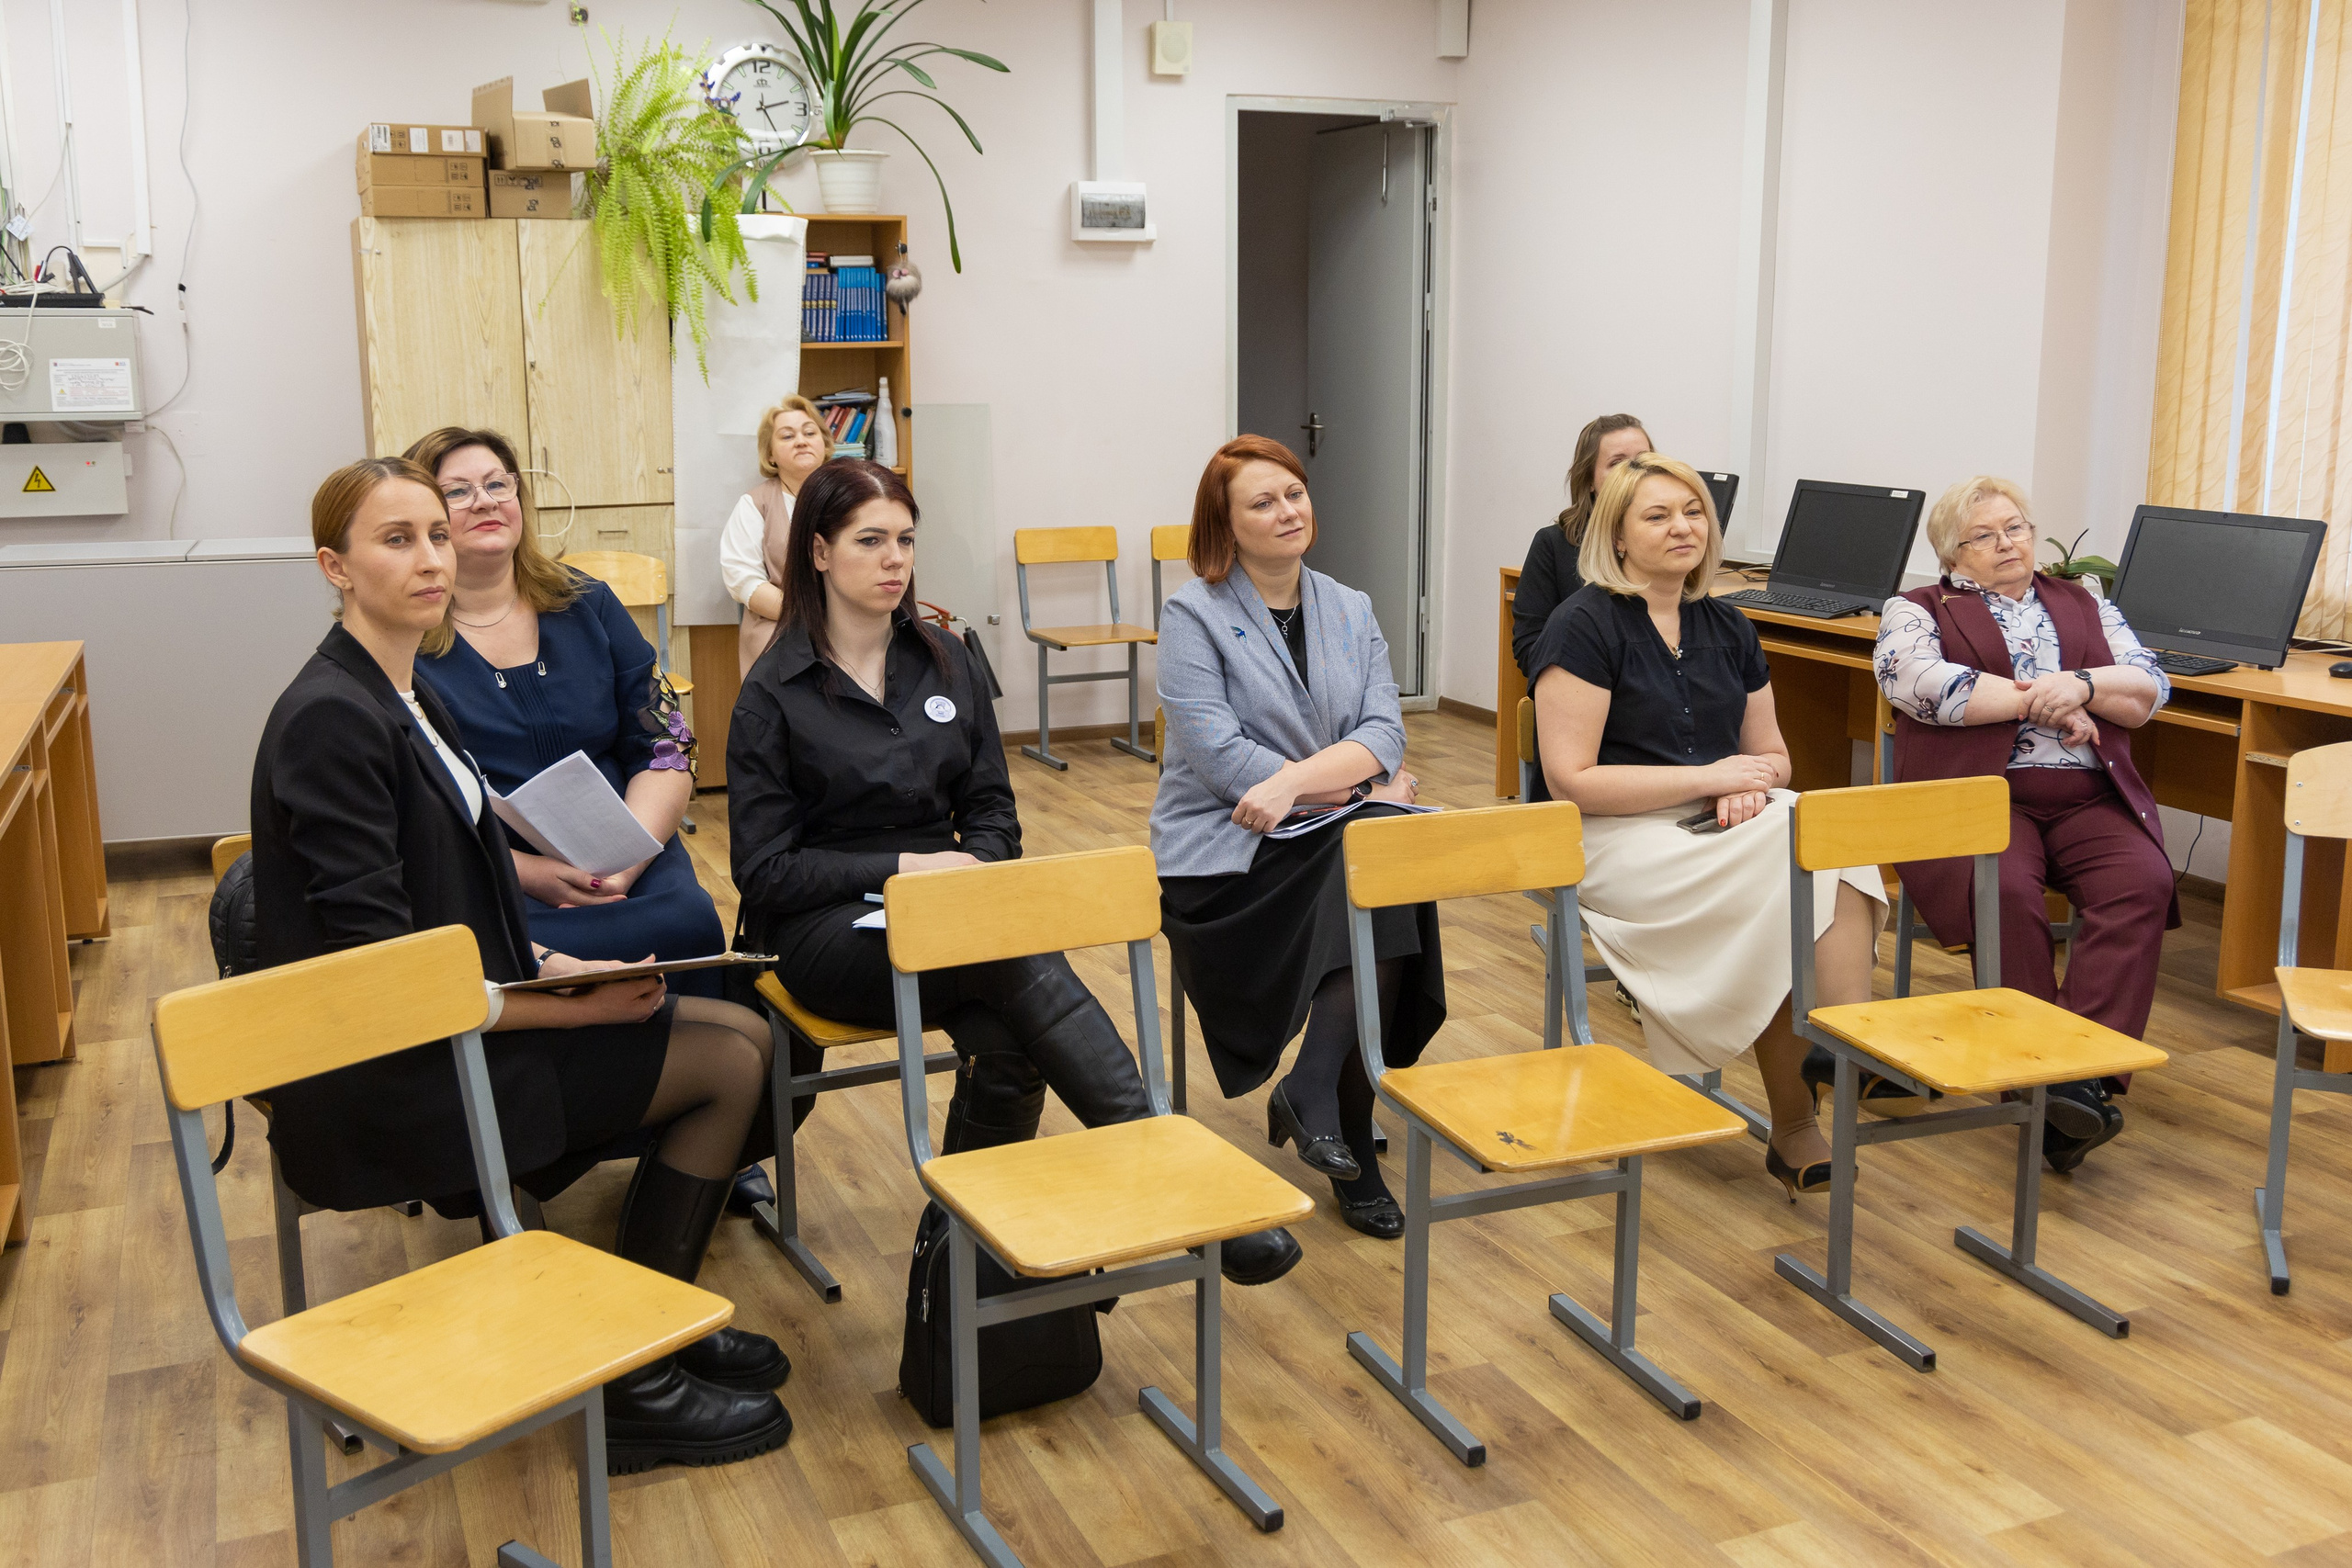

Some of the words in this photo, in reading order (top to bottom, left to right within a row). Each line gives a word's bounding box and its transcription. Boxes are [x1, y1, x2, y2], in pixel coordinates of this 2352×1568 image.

[752, 60, 771, 73] 12
[795, 101, 808, 117] 3
[813, 105, 823, 117] 15
